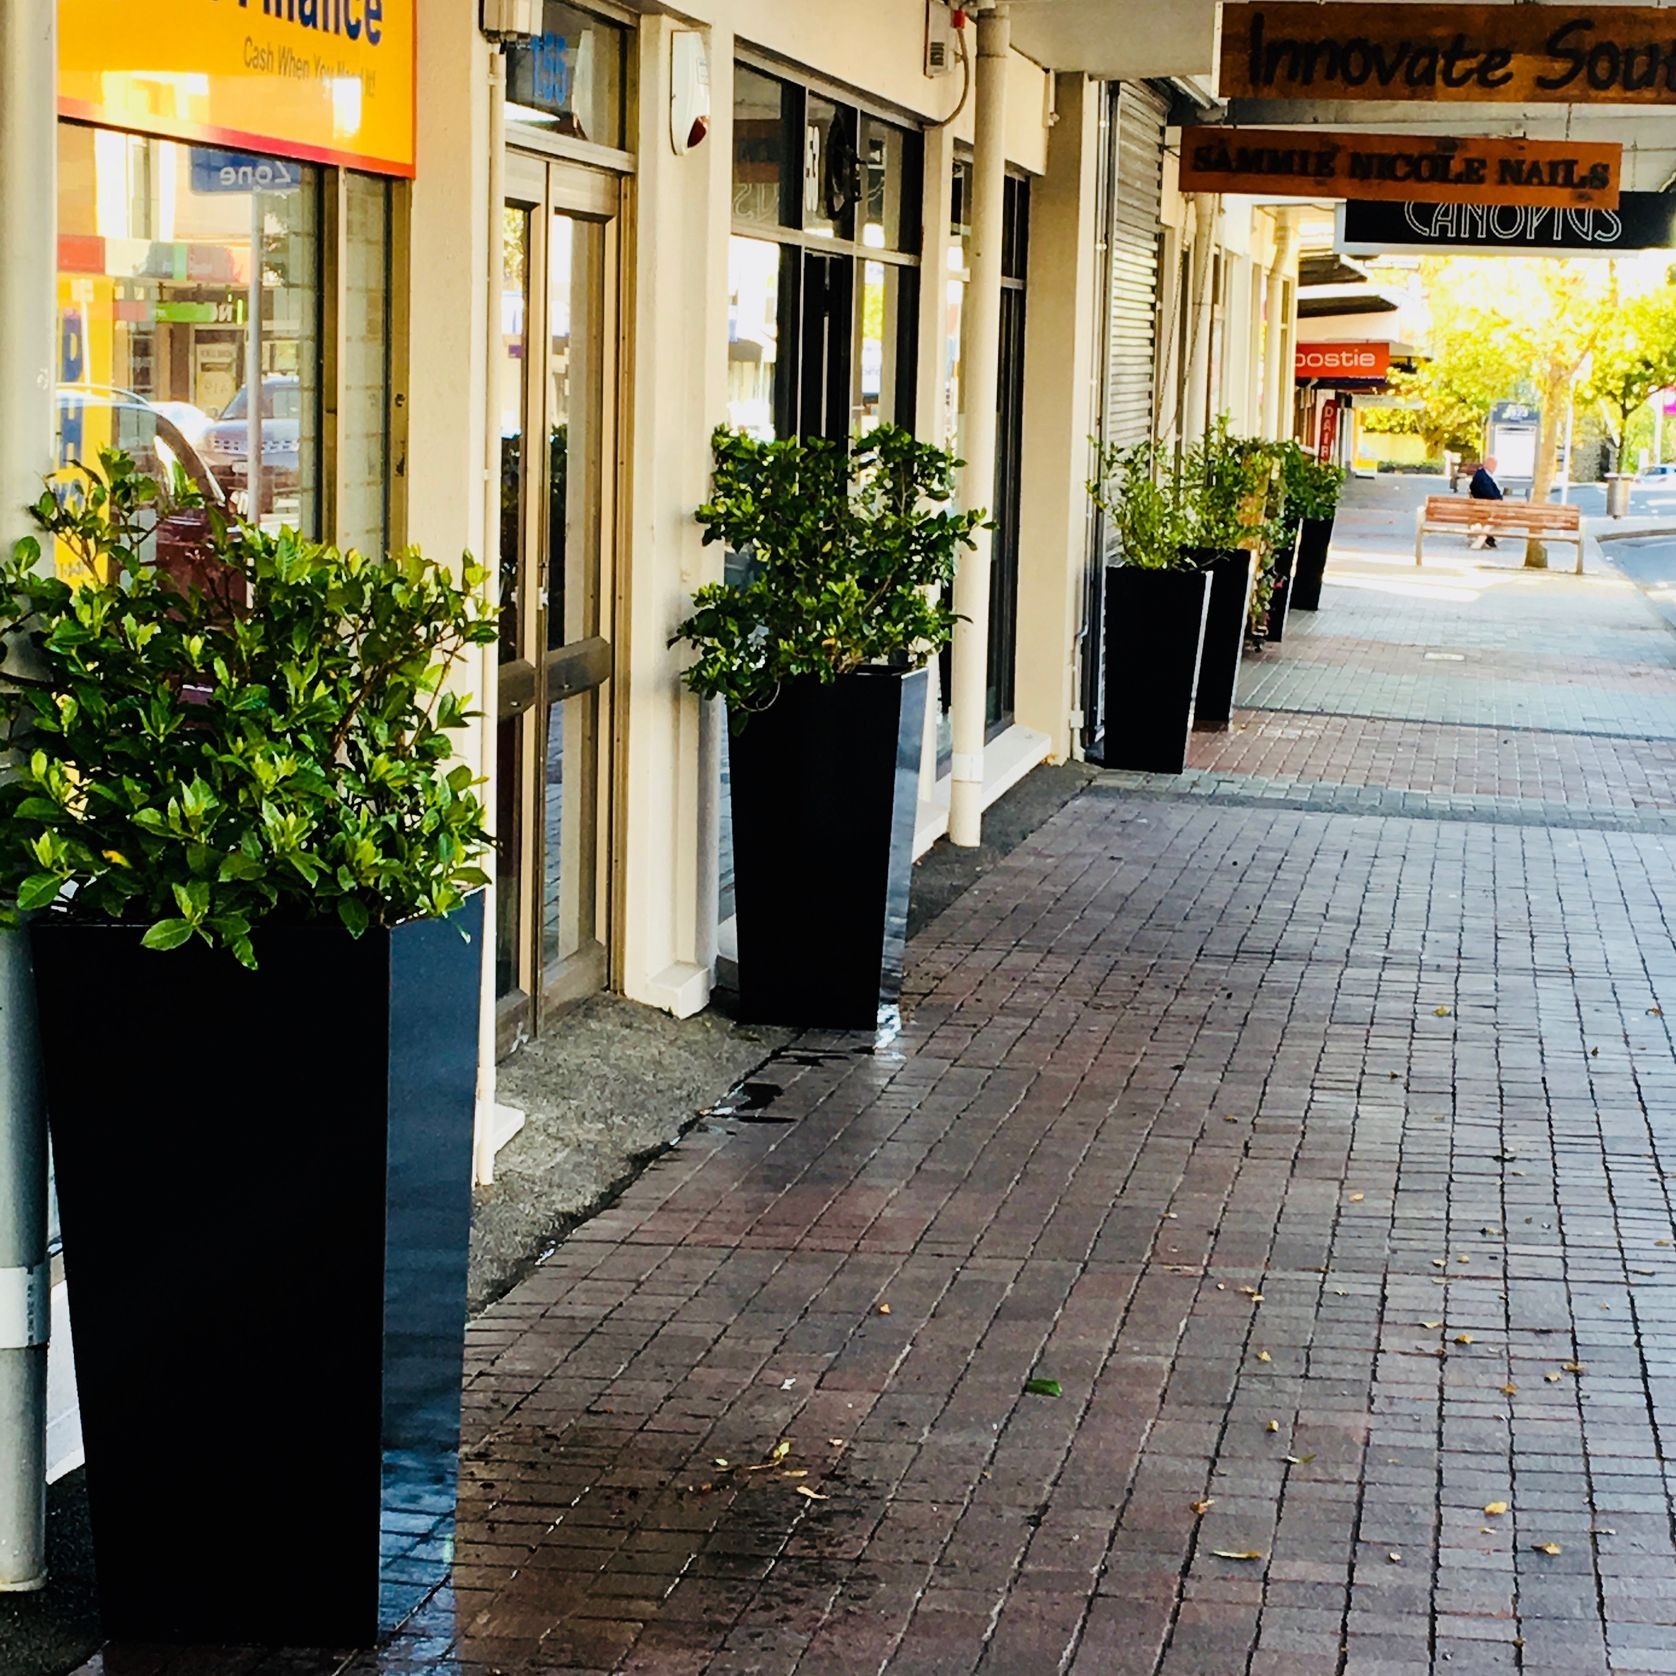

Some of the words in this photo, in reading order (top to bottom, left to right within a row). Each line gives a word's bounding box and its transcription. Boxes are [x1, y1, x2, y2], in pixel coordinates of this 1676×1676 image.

[239, 0, 384, 46] ance
[243, 36, 274, 73] Cash
[278, 45, 310, 80] When
[1250, 12, 1514, 88] Innovate
[1192, 146, 1336, 177] SAMMIE
[1349, 152, 1487, 184] NICOLE
[1498, 159, 1610, 189] NAILS
